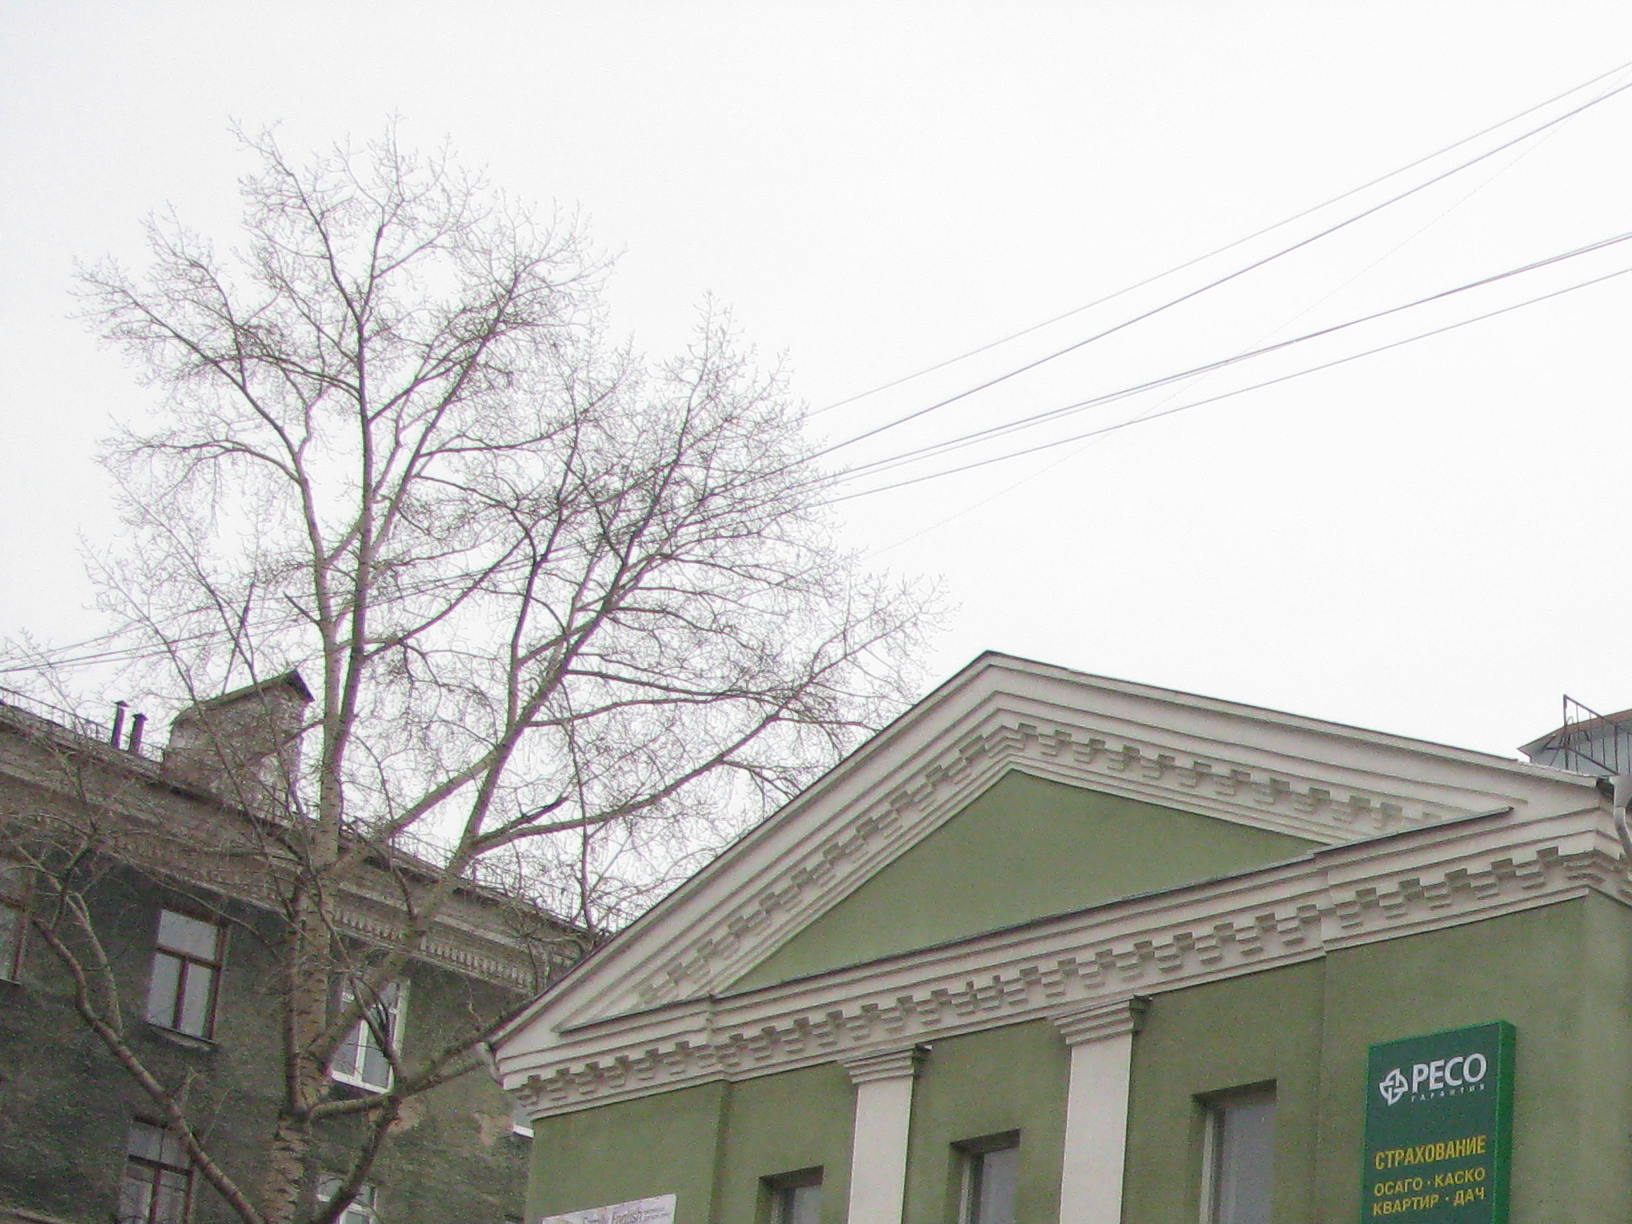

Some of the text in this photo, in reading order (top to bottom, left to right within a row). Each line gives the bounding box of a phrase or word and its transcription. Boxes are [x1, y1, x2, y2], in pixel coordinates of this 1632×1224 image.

[1411, 1052, 1488, 1094] РЕСО
[1375, 1135, 1487, 1170] СТРАХОВАНИЕ
[1373, 1166, 1486, 1197] ОСАГО КАСКО
[1372, 1185, 1486, 1216] КВАРТИР ДАЧ
